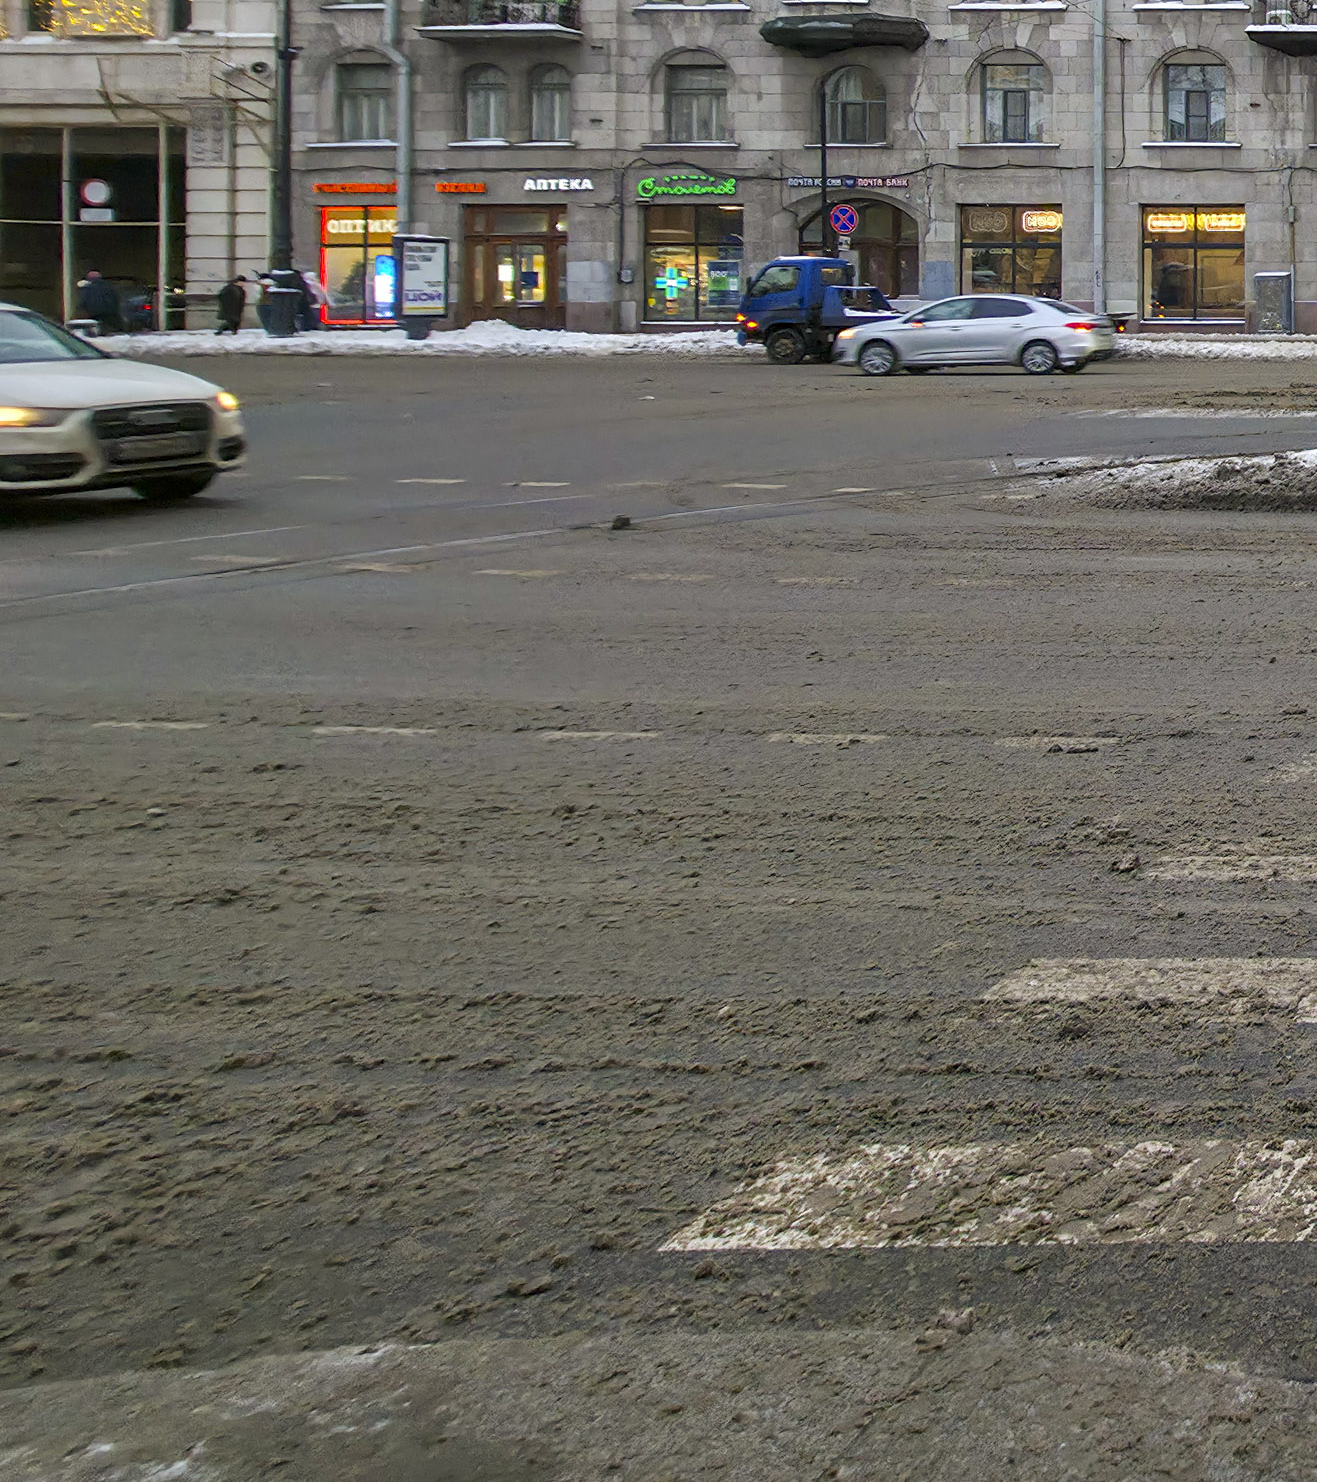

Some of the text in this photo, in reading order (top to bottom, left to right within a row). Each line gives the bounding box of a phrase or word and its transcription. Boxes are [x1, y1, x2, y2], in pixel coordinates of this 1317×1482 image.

[524, 178, 594, 191] АПТЕКА
[857, 178, 909, 187] ПОЧТА БАНК
[327, 219, 398, 234] ОПТИК
